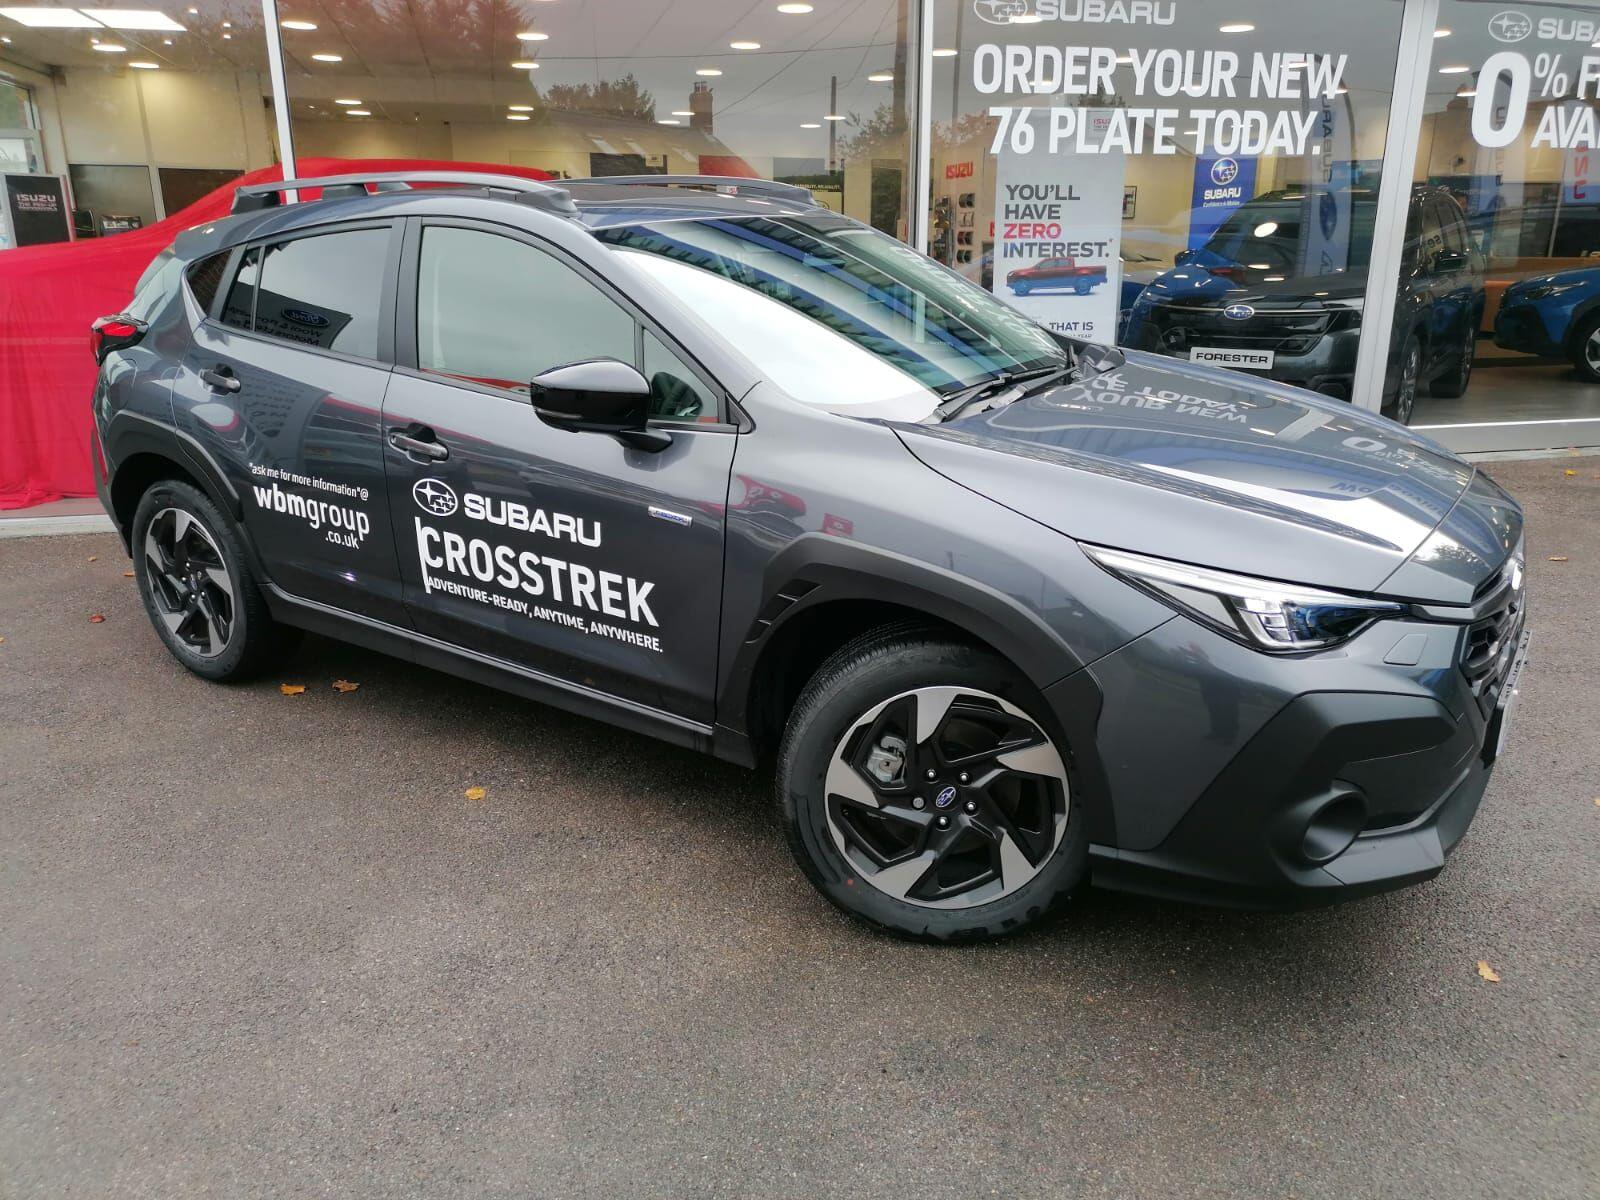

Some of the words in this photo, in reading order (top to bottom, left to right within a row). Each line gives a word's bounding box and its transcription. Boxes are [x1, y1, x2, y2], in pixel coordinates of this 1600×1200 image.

[1035, 0, 1176, 26] SUBARU
[973, 44, 1117, 95] ORDER
[1128, 49, 1238, 98] YOUR
[1249, 52, 1348, 99] NEW
[1472, 52, 1568, 148] 0%
[989, 107, 1035, 155] 76
[1049, 107, 1179, 155] PLATE
[1190, 109, 1320, 155] TODAY.
[1531, 106, 1600, 148] AVA
[946, 162, 973, 178] ISUZU
[16, 194, 56, 202] ISUZU
[1006, 185, 1080, 200] YOU'LL
[1204, 187, 1241, 200] SUBARU
[1004, 204, 1061, 219] HAVE
[1003, 223, 1062, 239] ZERO
[1049, 322, 1080, 331] THAT
[1083, 322, 1093, 331] IS
[1196, 352, 1268, 364] FORESTER
[266, 468, 280, 478] me
[280, 469, 292, 481] for
[291, 474, 312, 486] more
[253, 483, 370, 542] wbmgroup
[463, 492, 602, 547] SUBARU
[325, 530, 360, 550] .co.uk
[421, 526, 660, 628] CROSSTREK
[533, 605, 589, 634] ANYTIME,
[590, 621, 663, 652] ANYWHERE.
